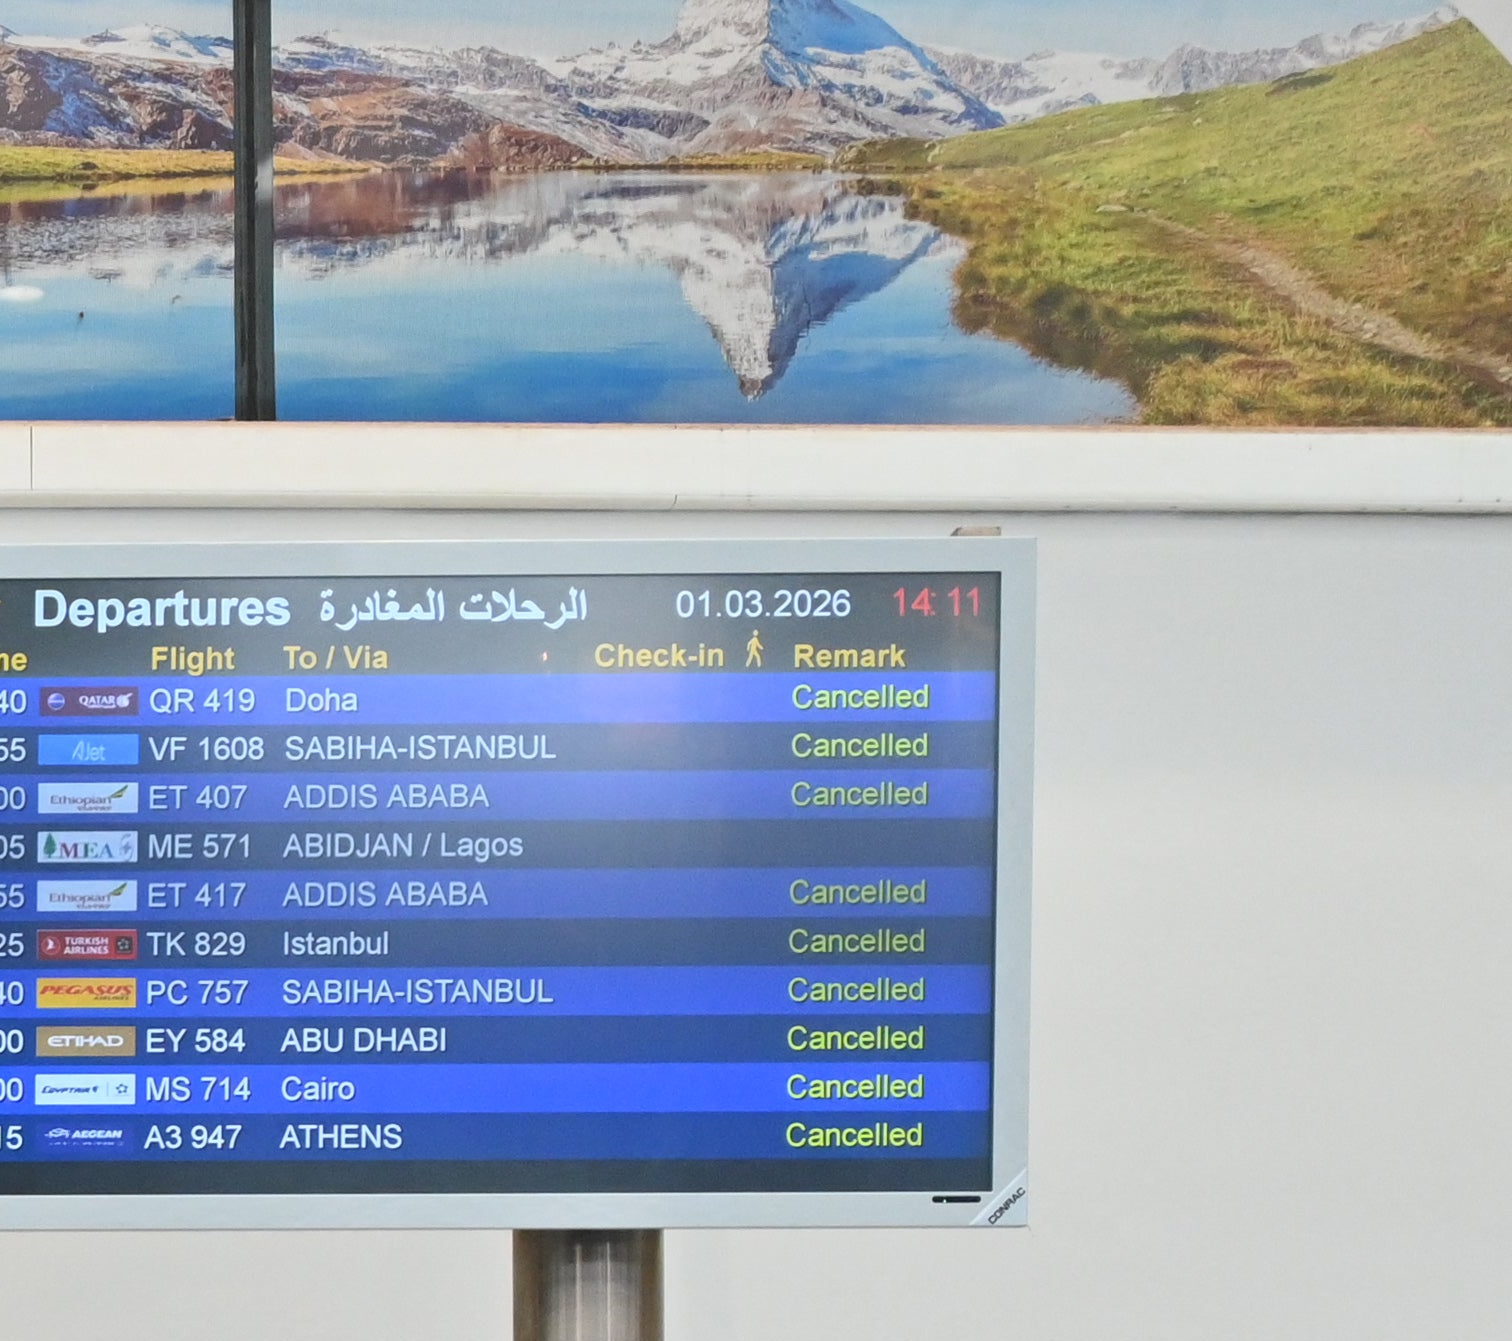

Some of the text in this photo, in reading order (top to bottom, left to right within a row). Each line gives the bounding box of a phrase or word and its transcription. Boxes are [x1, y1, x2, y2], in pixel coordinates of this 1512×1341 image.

[34, 589, 291, 634] Departures
[319, 585, 588, 631] الرحلات المغادرة
[675, 589, 851, 619] 01.03.2026
[151, 646, 236, 677] Flight
[282, 645, 317, 670] To
[342, 645, 388, 669] Via
[594, 643, 724, 668] Check-in
[794, 643, 906, 668] Remark
[148, 736, 188, 761] VF
[198, 735, 265, 761] 1608
[285, 734, 557, 761] SABIHA-ISTANBUL
[791, 732, 928, 758] Cancelled
[148, 833, 193, 859] ME
[202, 833, 250, 859] 571
[282, 832, 413, 858] ABIDJAN
[440, 832, 524, 863] Lagos
[146, 931, 186, 956] TK
[194, 931, 246, 956] 829
[283, 930, 389, 956] Istanbul
[788, 928, 925, 954] Cancelled
[46, 1034, 124, 1048] ETIHAD
[146, 1028, 187, 1053] EY
[194, 1028, 246, 1053] 584
[280, 1027, 344, 1053] ABU
[353, 1027, 446, 1052] DHABI
[787, 1025, 924, 1051] Cancelled
